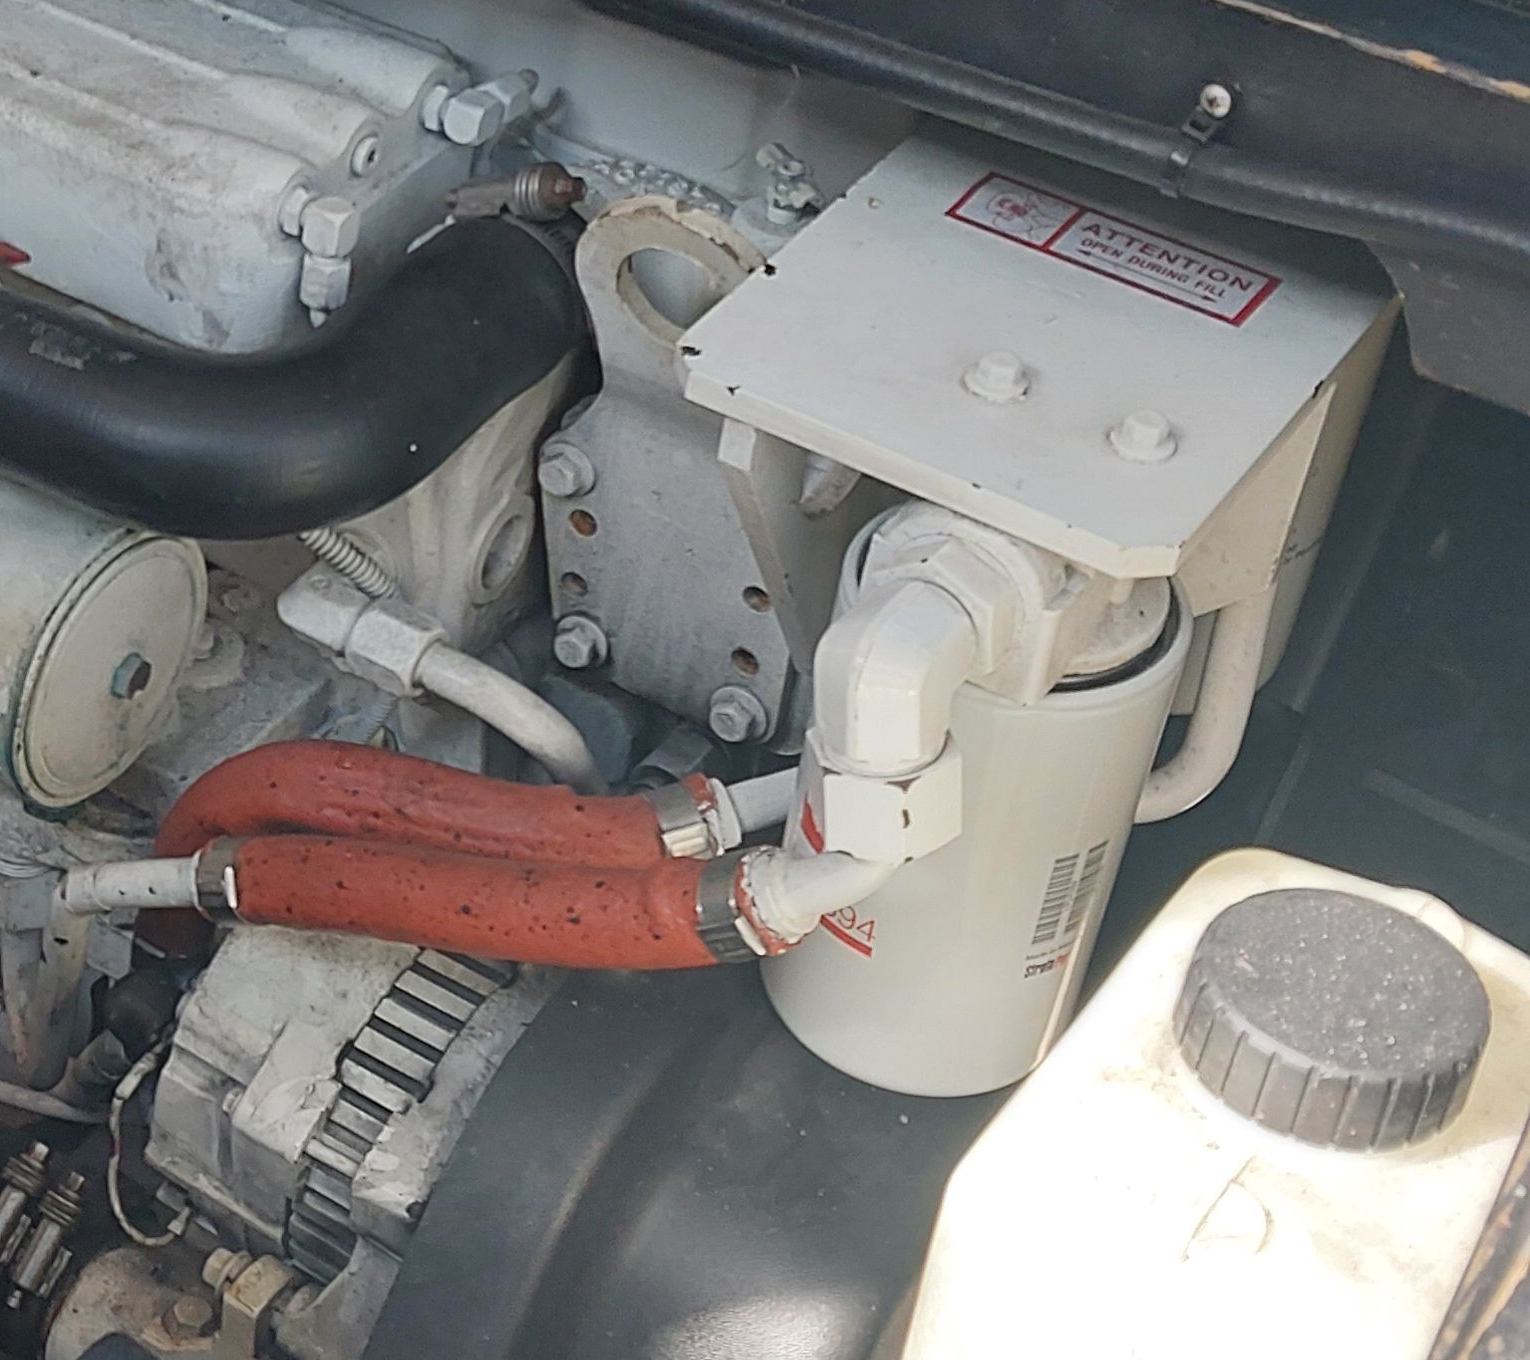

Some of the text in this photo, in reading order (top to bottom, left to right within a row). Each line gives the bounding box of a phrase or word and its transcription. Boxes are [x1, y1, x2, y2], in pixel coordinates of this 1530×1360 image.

[1080, 238, 1226, 298] OPEN DURING FILL
[1082, 222, 1253, 291] ATTENTION
